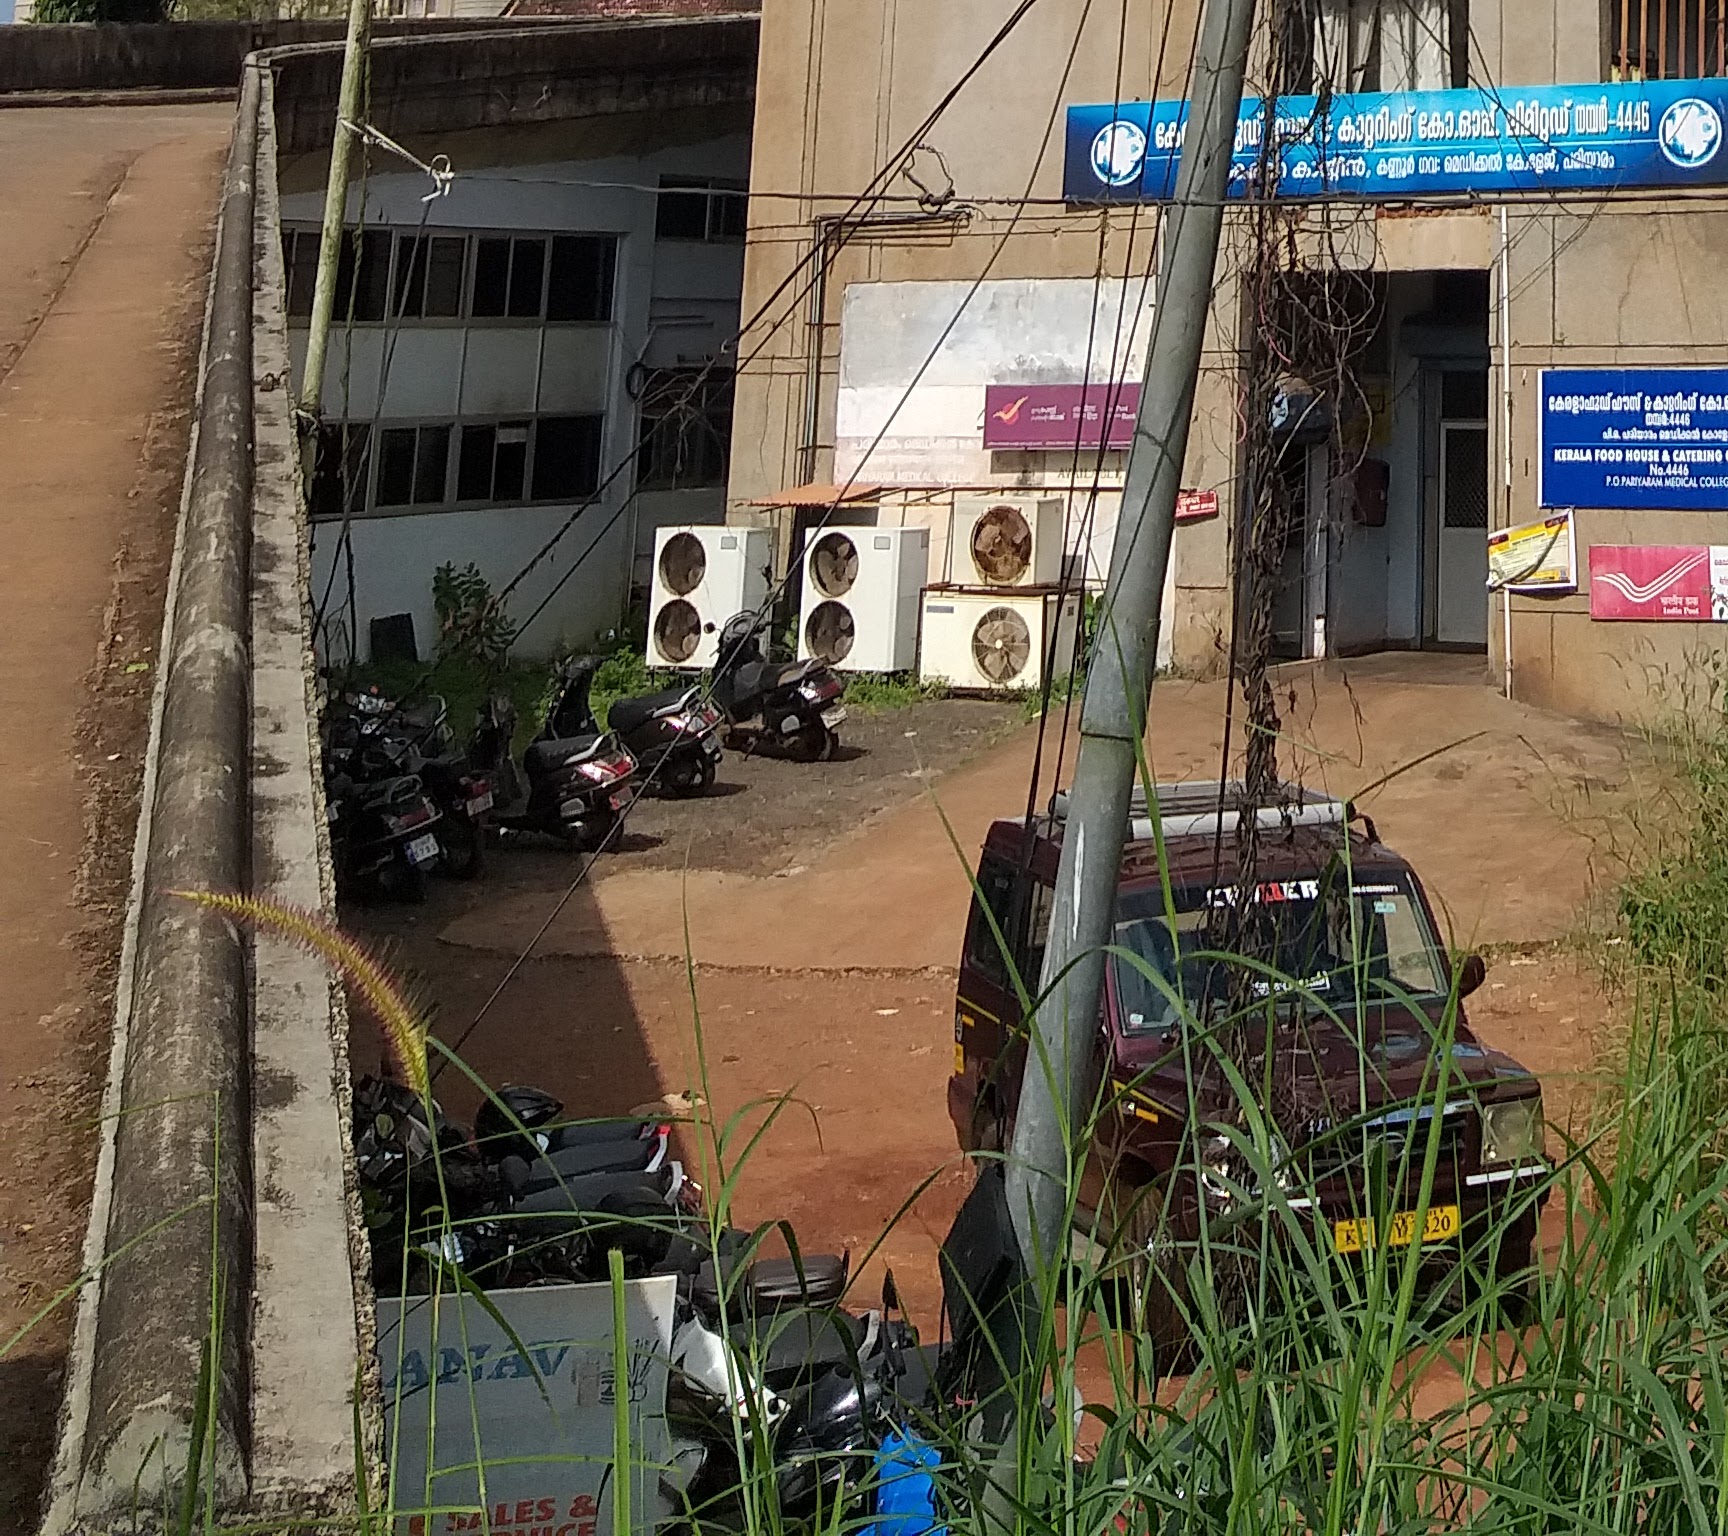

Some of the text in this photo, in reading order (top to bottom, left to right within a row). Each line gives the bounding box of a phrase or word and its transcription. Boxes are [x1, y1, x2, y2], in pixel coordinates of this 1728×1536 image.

[1554, 448, 1592, 462] KERALA
[1594, 449, 1623, 462] FOOD
[1625, 449, 1660, 462] HOUSE
[1661, 449, 1671, 462] &
[1672, 449, 1723, 463] CATERING
[1649, 463, 1690, 476] No.4446
[1664, 477, 1698, 488] MEDICAL
